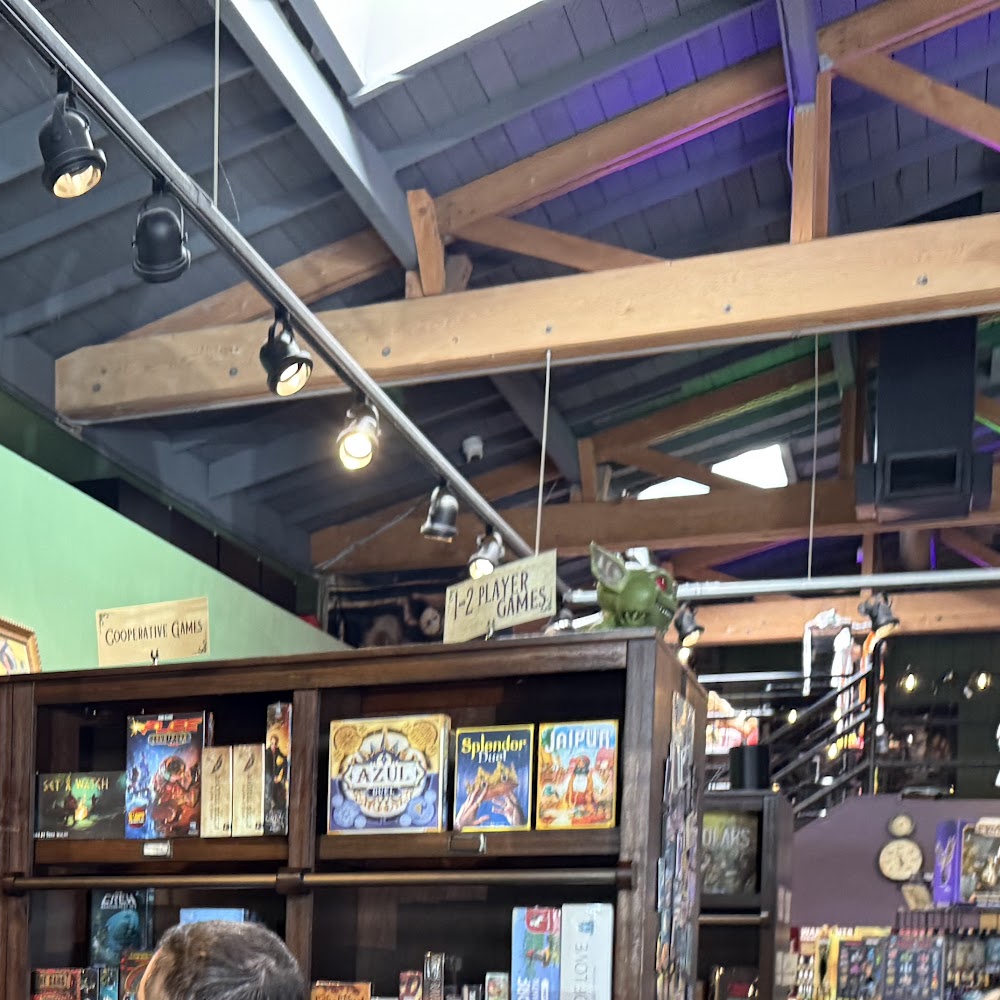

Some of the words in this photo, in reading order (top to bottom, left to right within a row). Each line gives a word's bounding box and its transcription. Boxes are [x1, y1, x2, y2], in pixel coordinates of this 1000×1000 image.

[451, 586, 474, 620] 1-2
[478, 571, 529, 607] PLAYER
[496, 585, 547, 619] GAMES
[105, 622, 168, 646] COOPERATIVE
[171, 618, 203, 639] GAMES
[461, 734, 527, 760] Splendor
[546, 727, 612, 752] JAIPUR
[75, 777, 109, 791] WATCH
[358, 765, 410, 783] AZUL
[575, 943, 589, 982] LOVE
